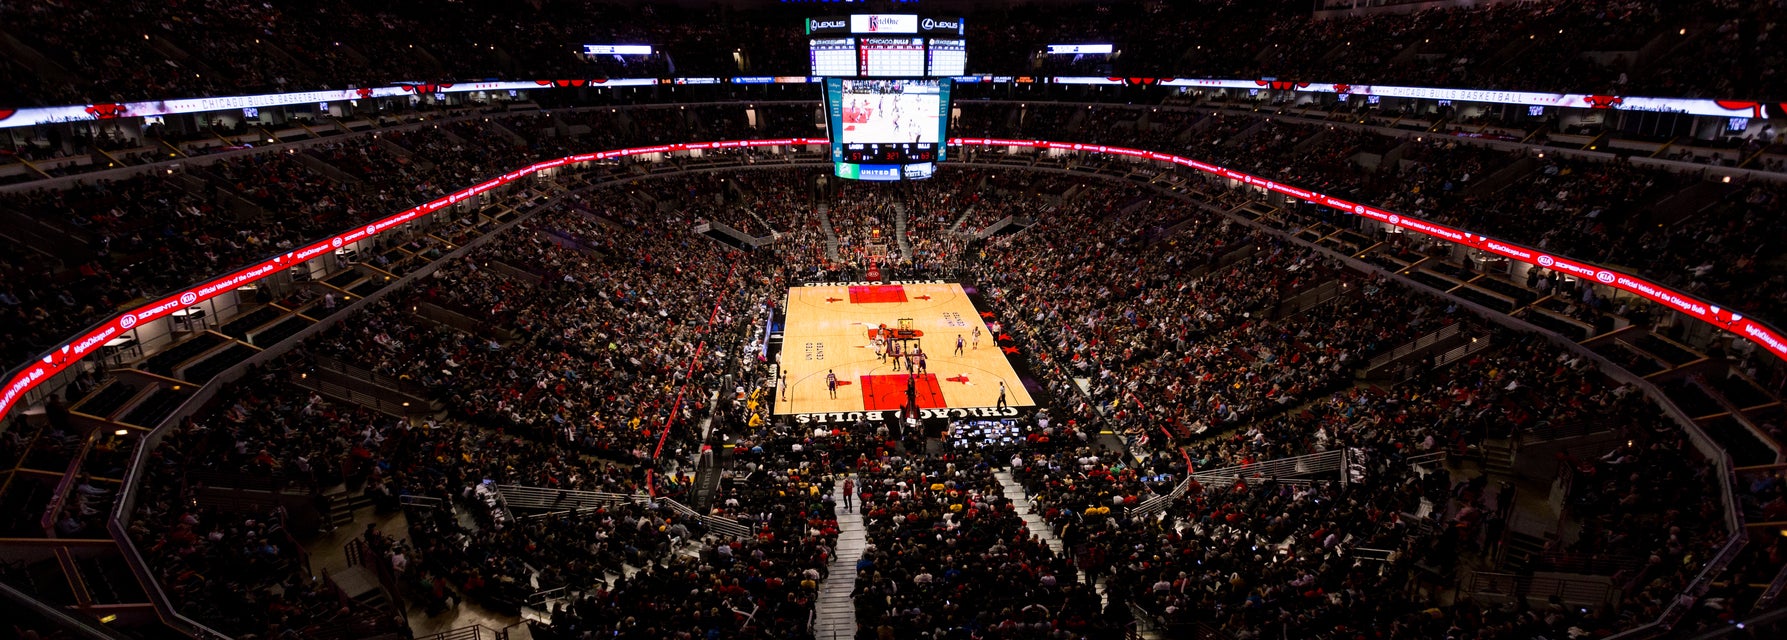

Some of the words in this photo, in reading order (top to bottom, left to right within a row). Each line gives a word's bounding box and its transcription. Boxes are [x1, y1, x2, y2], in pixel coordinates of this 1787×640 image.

[202, 98, 244, 110] CHICAGO
[248, 95, 274, 106] BULLS
[279, 93, 326, 104] BASKETBALL
[1393, 88, 1425, 97] CHICAGO
[1430, 89, 1456, 99] BULLS
[1461, 90, 1522, 103] BASKETBALL
[1555, 261, 1594, 276] SORENTO
[1618, 278, 1638, 288] Official
[1638, 284, 1655, 295] Vehicle
[1661, 293, 1671, 301] the
[1670, 296, 1691, 310] Chicago
[1691, 304, 1706, 315] Bulls
[74, 326, 116, 354] MyKiaChicago.com
[138, 300, 179, 320] SORENTO
[198, 286, 216, 296] Official
[216, 280, 233, 290] Vehicle
[246, 269, 263, 278] Chicago
[263, 264, 273, 273] Bulls
[796, 411, 884, 423] BULLS
